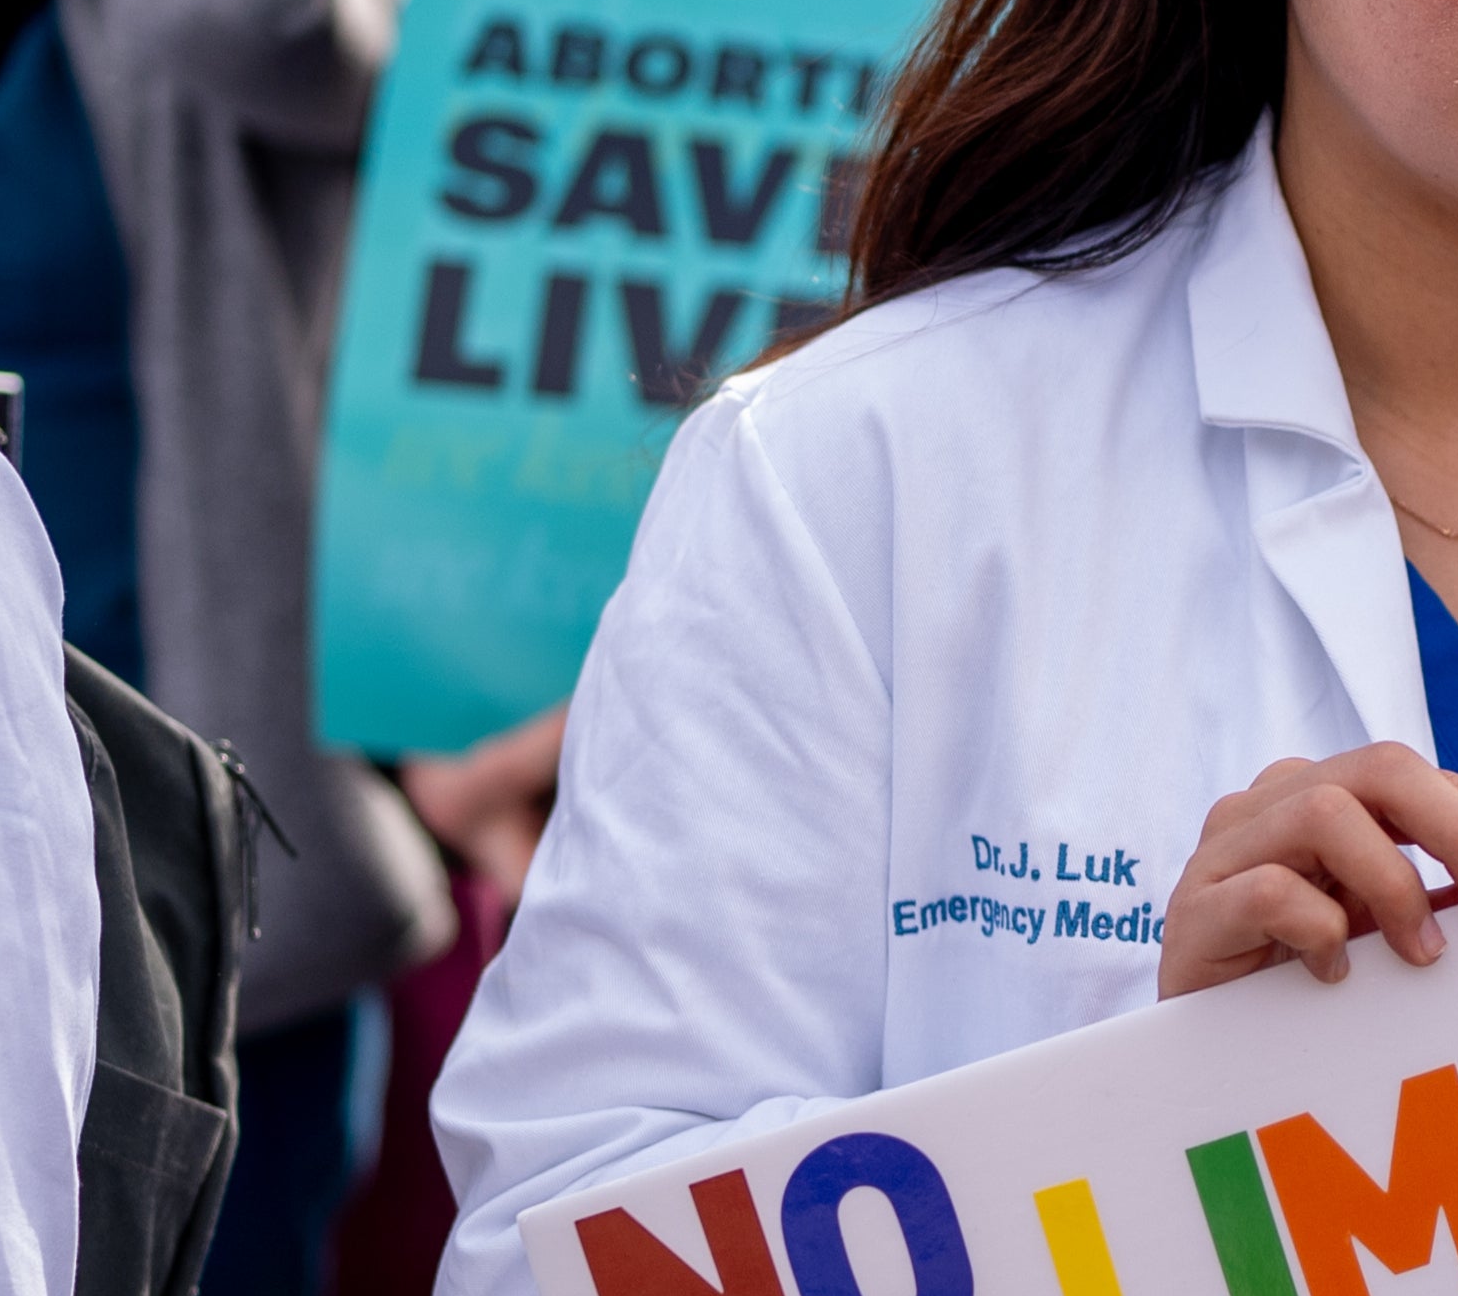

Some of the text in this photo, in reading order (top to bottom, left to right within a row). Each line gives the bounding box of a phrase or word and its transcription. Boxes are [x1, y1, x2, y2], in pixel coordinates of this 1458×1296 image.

[407, 255, 842, 410] LIV
[1056, 842, 1141, 887] Luk
[892, 893, 1046, 945] Emergency
